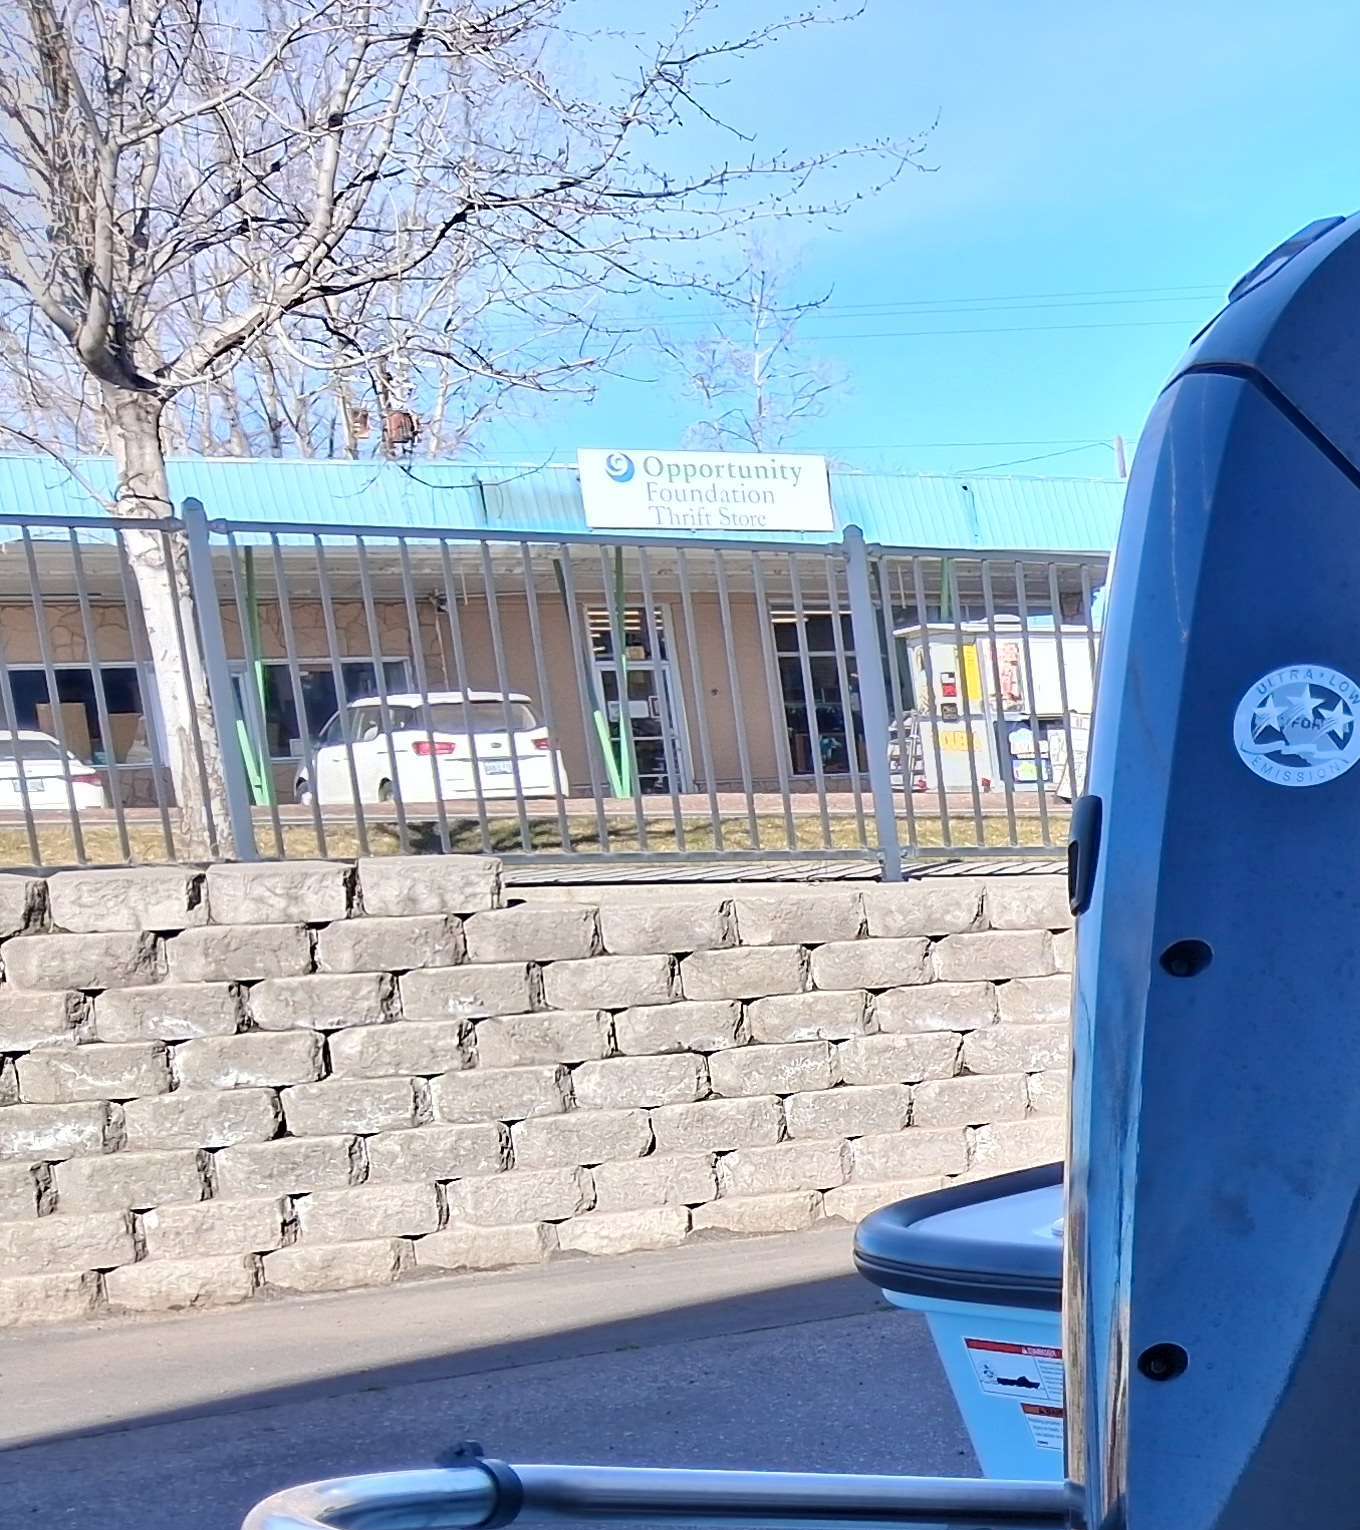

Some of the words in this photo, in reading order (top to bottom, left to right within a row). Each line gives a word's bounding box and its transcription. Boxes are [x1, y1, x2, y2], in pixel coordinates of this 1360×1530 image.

[643, 456, 802, 487] Opportunity
[646, 481, 775, 504] Foundation
[648, 506, 711, 527] Thrift
[719, 507, 768, 527] Store
[1251, 757, 1342, 782] EMISSION
